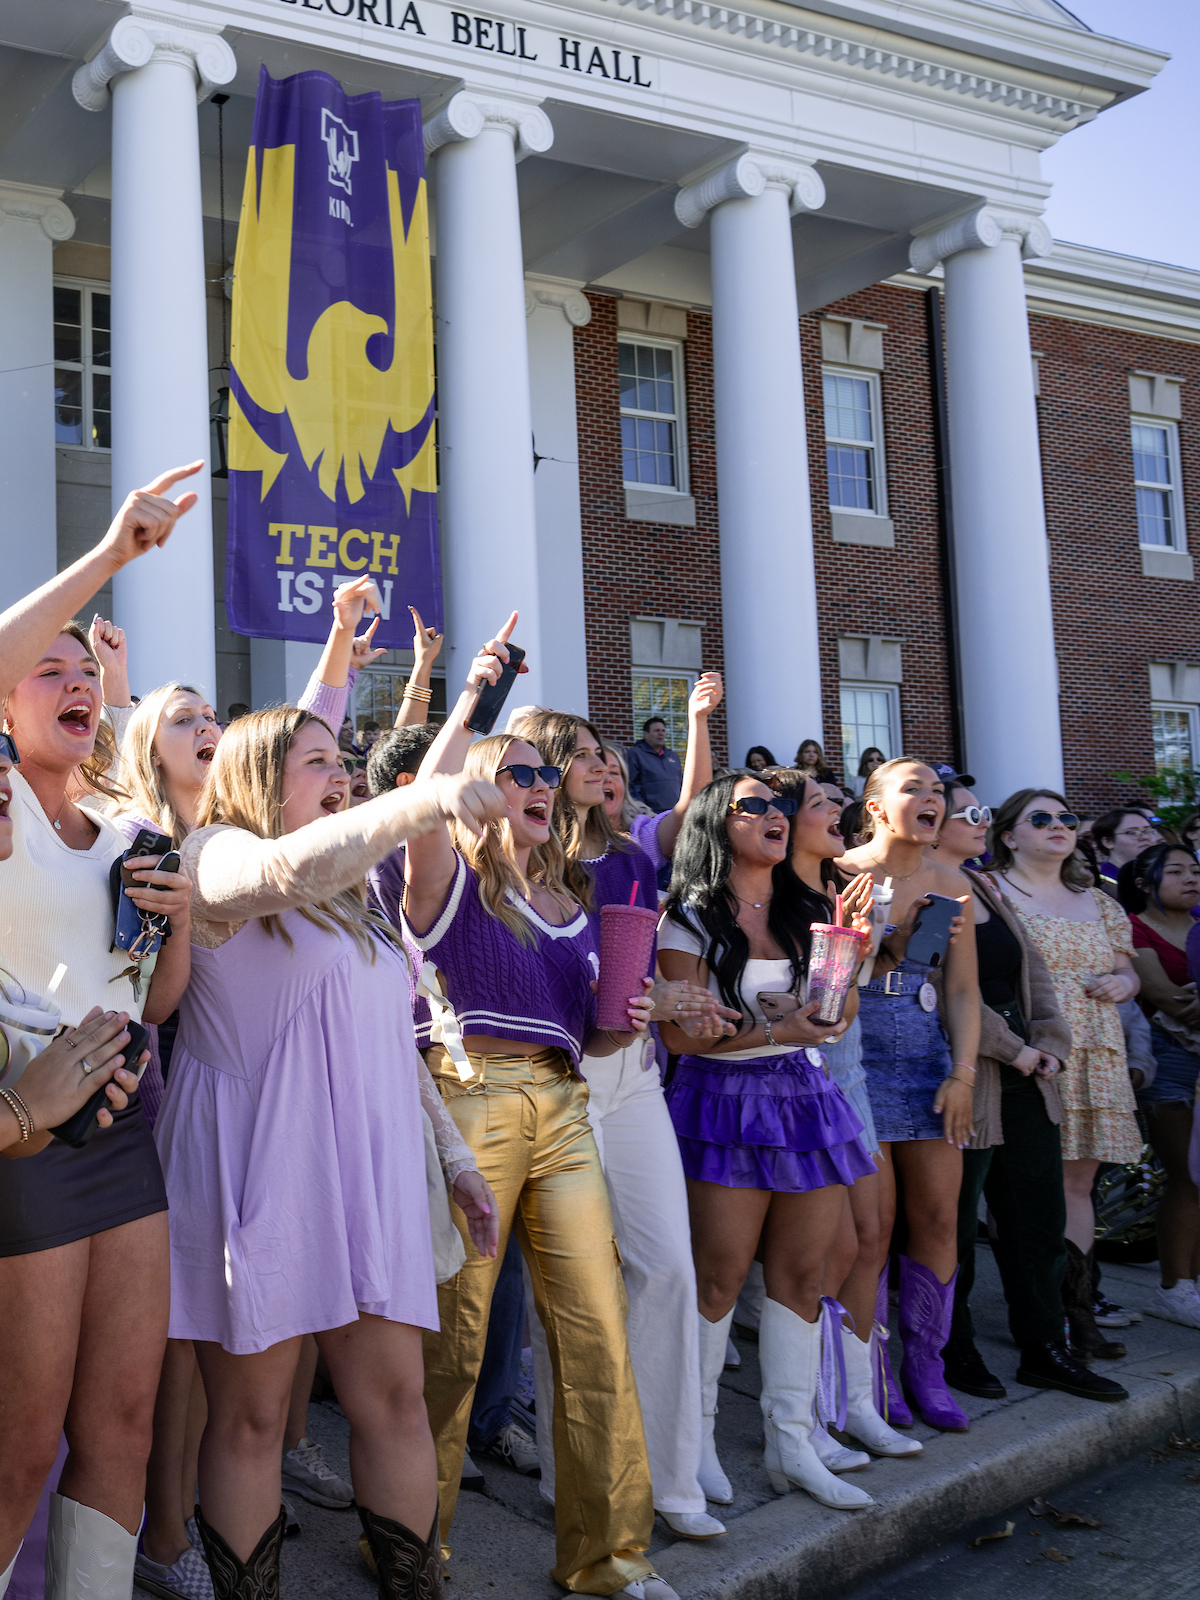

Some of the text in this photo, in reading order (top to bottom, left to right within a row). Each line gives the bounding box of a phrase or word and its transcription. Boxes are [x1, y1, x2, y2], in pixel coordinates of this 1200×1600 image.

[280, 0, 652, 87] ORIA BELL HALL
[268, 523, 400, 575] TECH
[277, 570, 324, 615] IS
